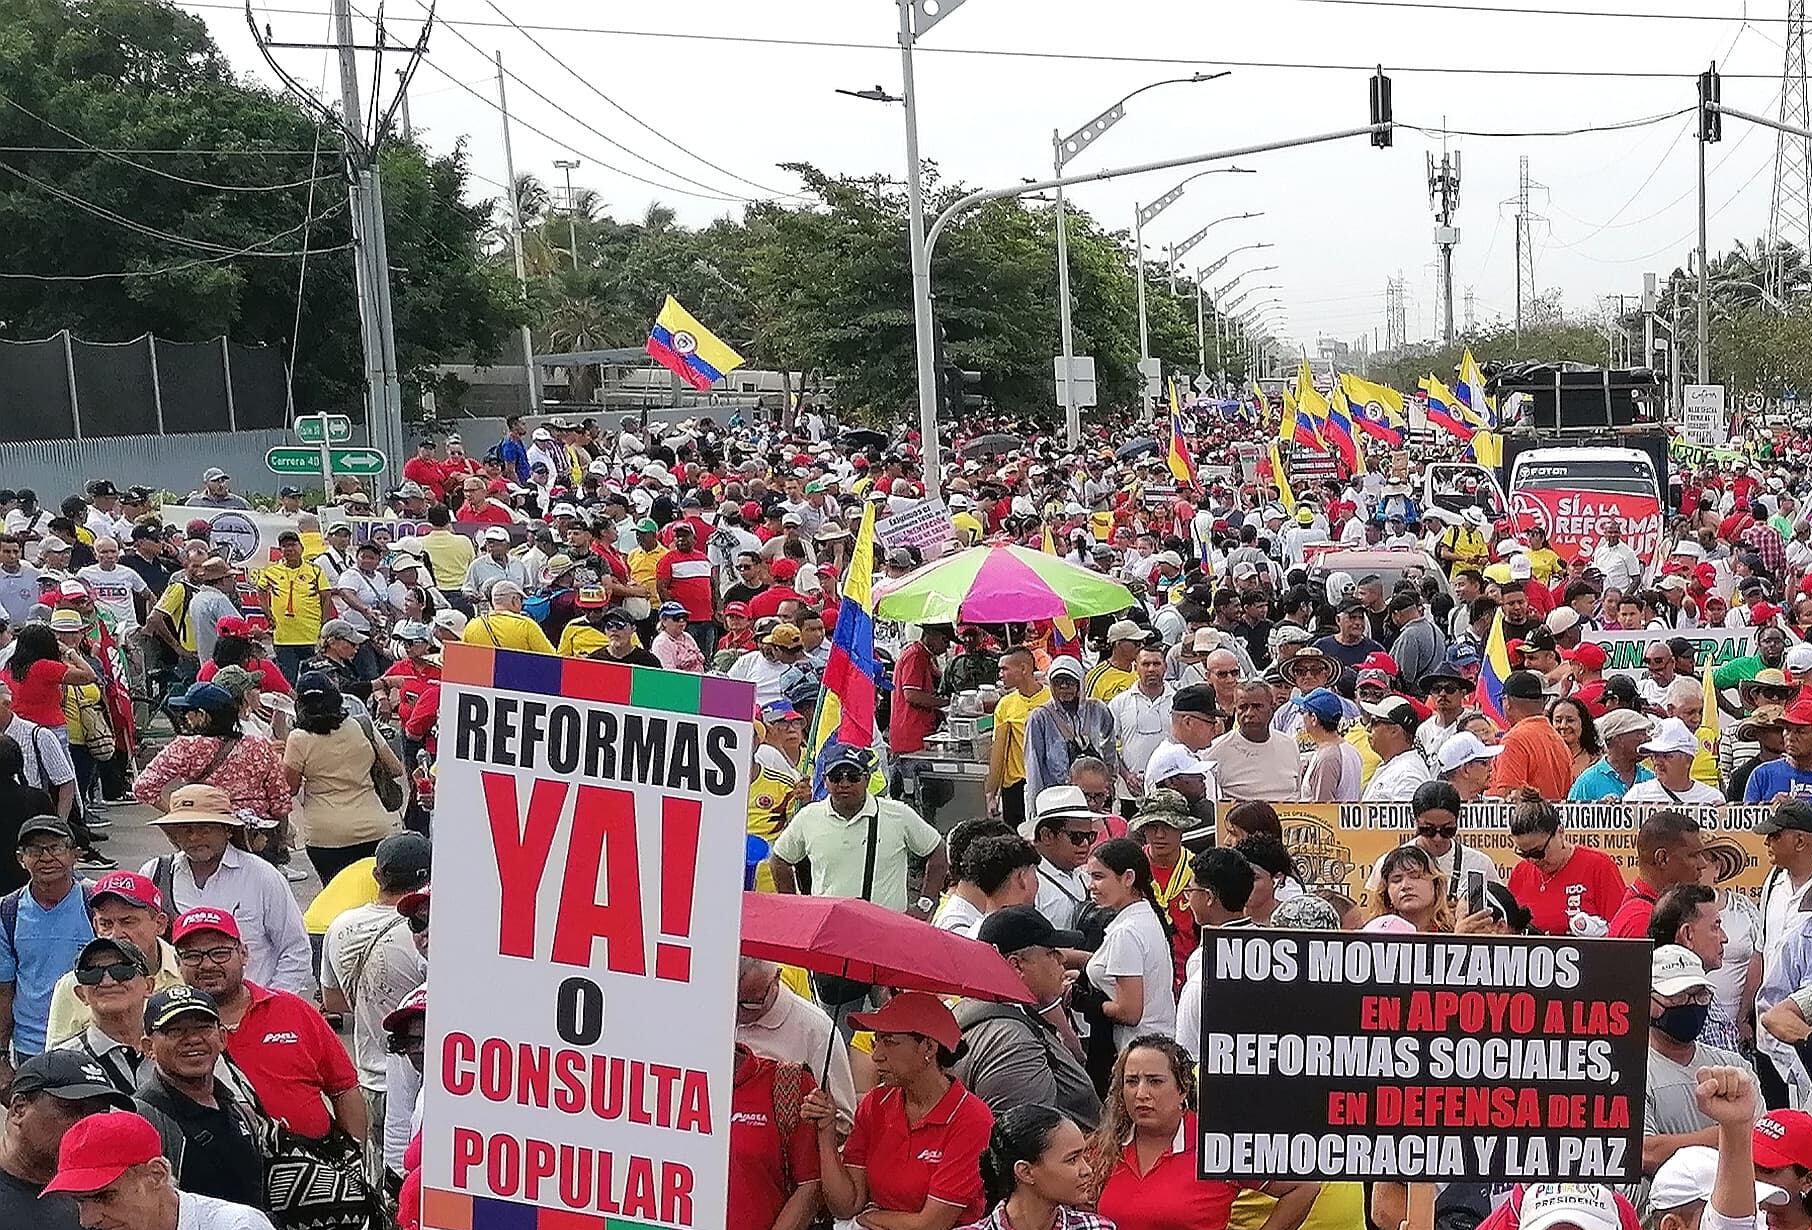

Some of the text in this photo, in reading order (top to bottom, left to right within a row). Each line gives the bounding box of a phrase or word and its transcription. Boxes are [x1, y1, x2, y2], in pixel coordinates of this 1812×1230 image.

[270, 455, 305, 467] Carrera
[1530, 467, 1568, 476] FOTON
[1558, 493, 1621, 516] SÍ A LA
[455, 692, 738, 797] REFORMAS
[1340, 805, 1361, 829] NO
[1700, 806, 1718, 830] ES
[481, 770, 703, 983] YA!
[1216, 938, 1581, 989] NOS MOVILIZAMOS
[555, 976, 604, 1047] O
[1361, 990, 1630, 1036] EN APOYO A LAS
[1207, 1033, 1620, 1085] REFORMAS SOCIALES,
[440, 1031, 714, 1136] CONSULTA
[1327, 1085, 1630, 1129] EN DEFENSA DE LA
[451, 1127, 696, 1227] POPULAR
[1203, 1132, 1628, 1177] DEMOCRACIA Y LA PAZ
[1535, 1196, 1608, 1210] PRESIDENTE
